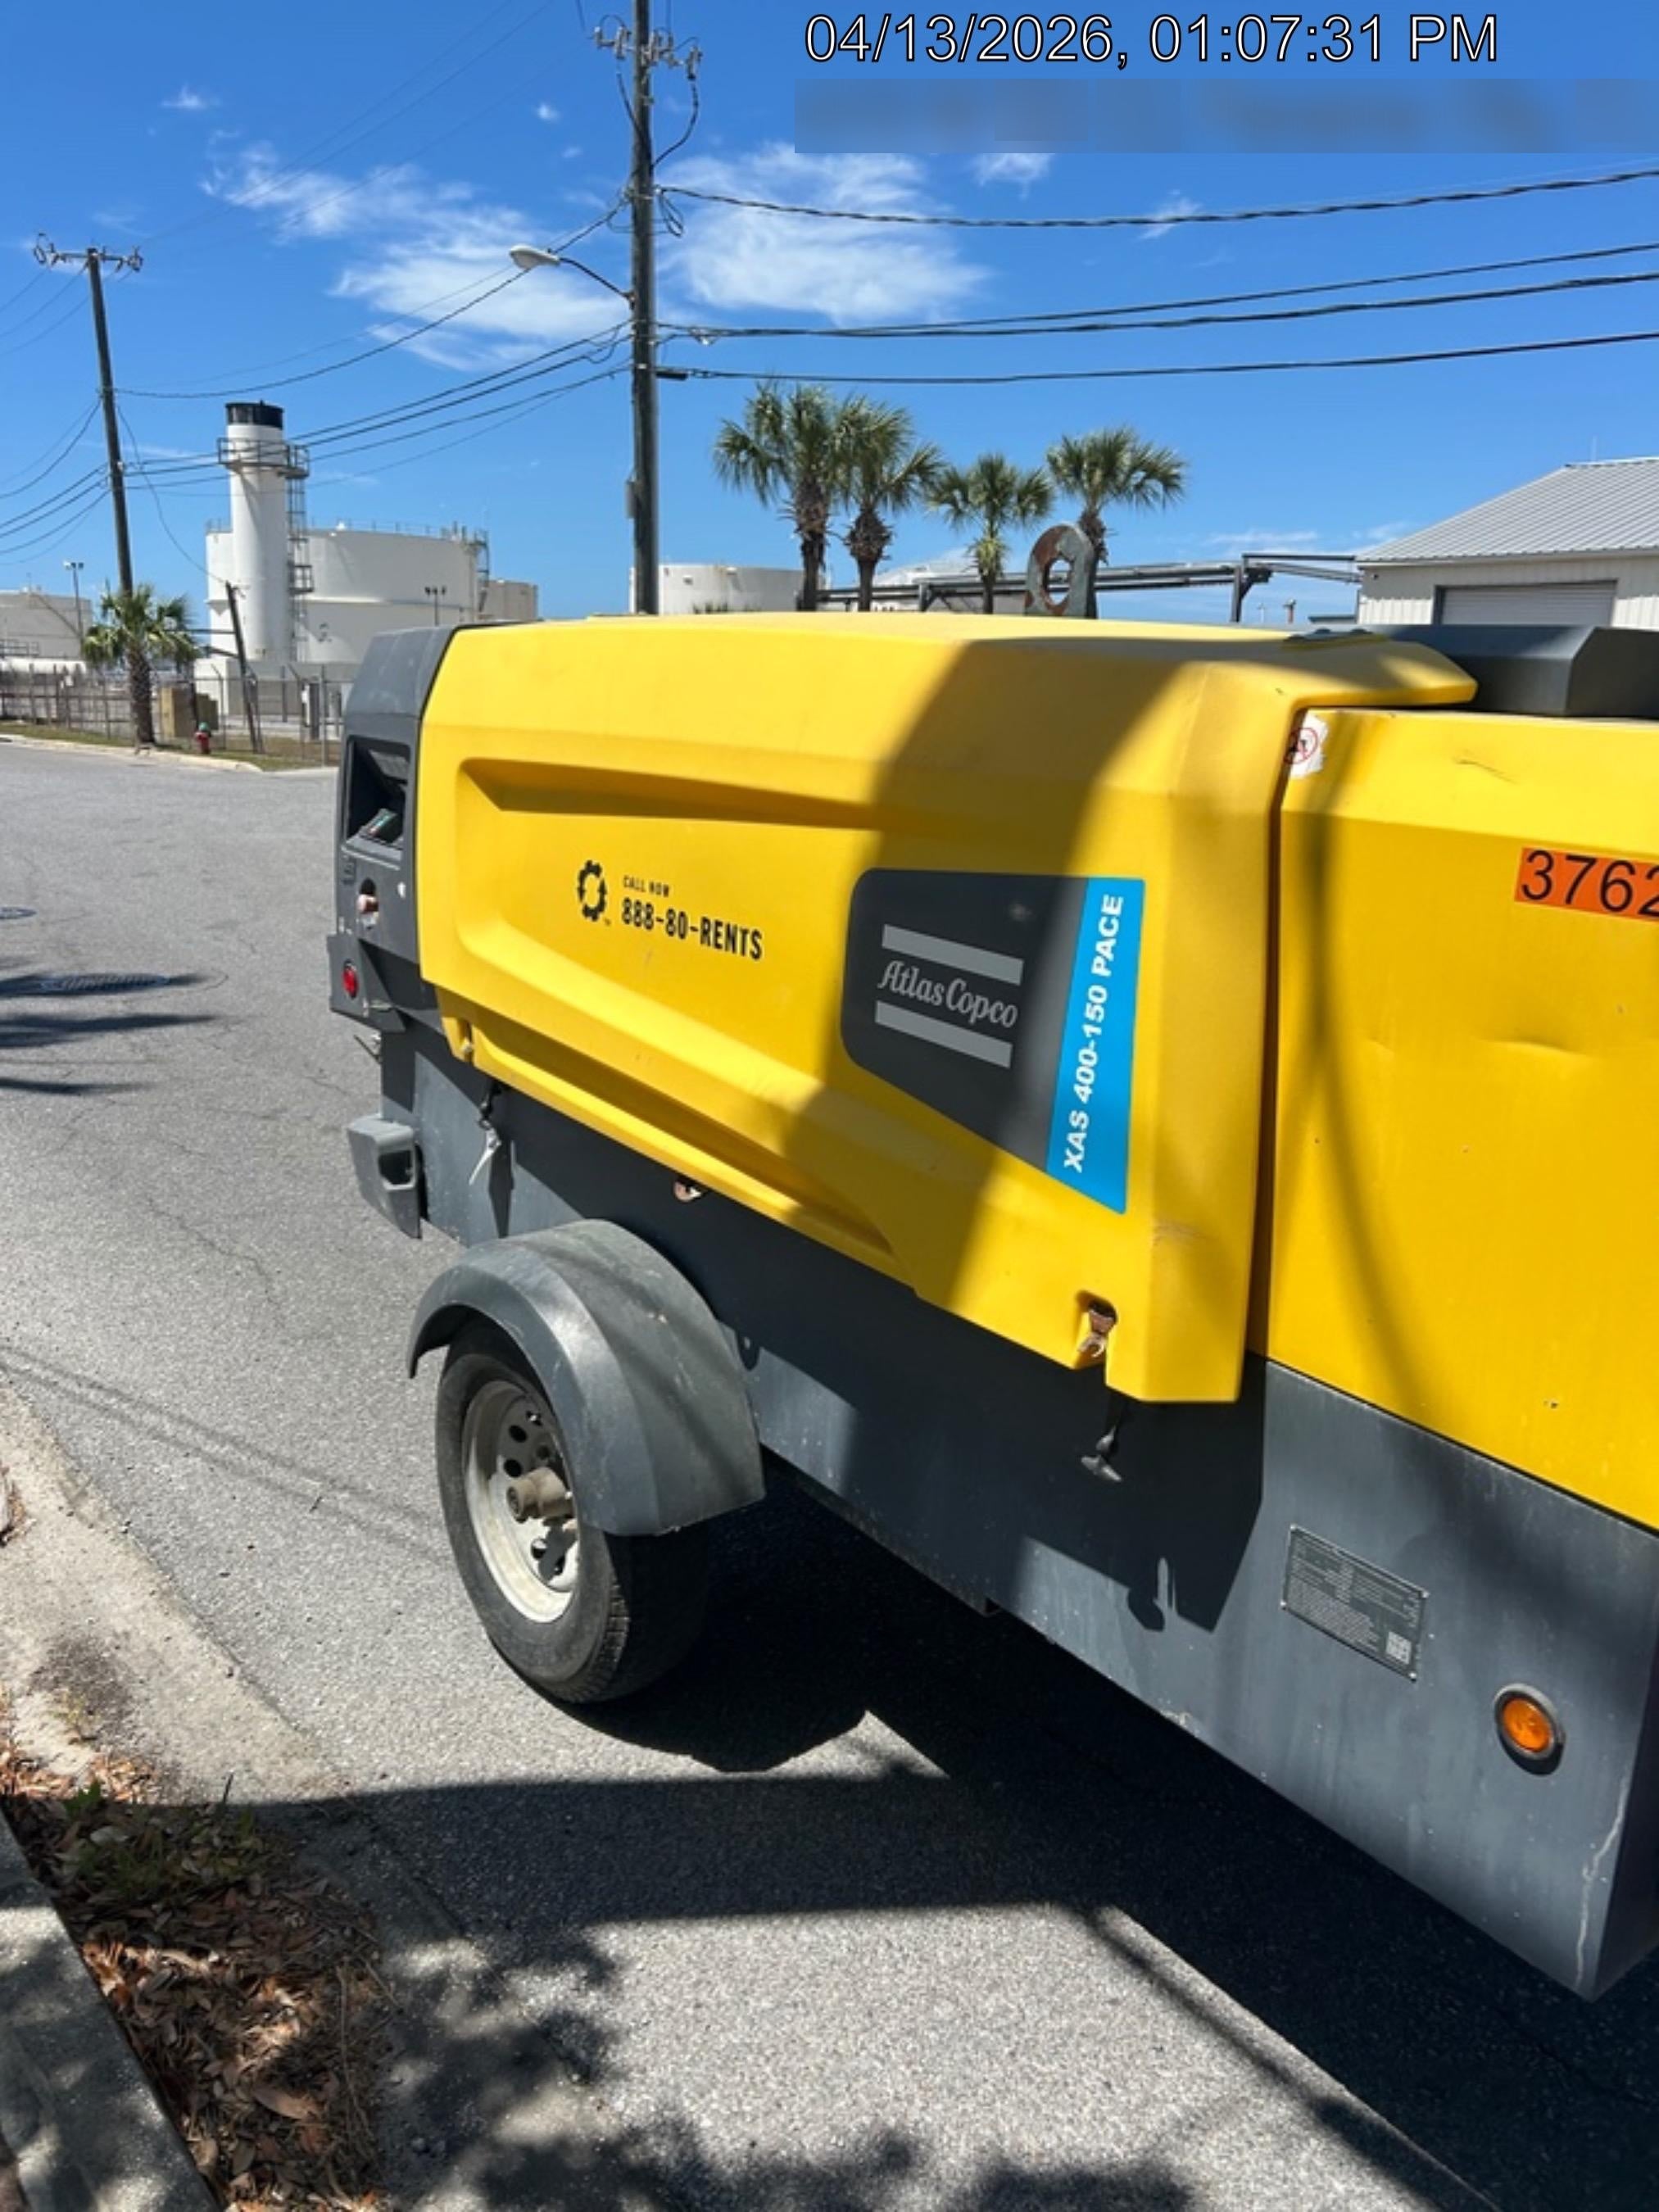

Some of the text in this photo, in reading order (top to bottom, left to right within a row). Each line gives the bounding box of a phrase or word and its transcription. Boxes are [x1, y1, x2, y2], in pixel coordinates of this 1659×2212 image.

[623, 875, 670, 897] CALL NOW
[622, 898, 762, 960] 888-80-RENTS
[877, 959, 1018, 1028] Atlas Copco
[1064, 894, 1124, 1172] XAS 400-150 PACE
